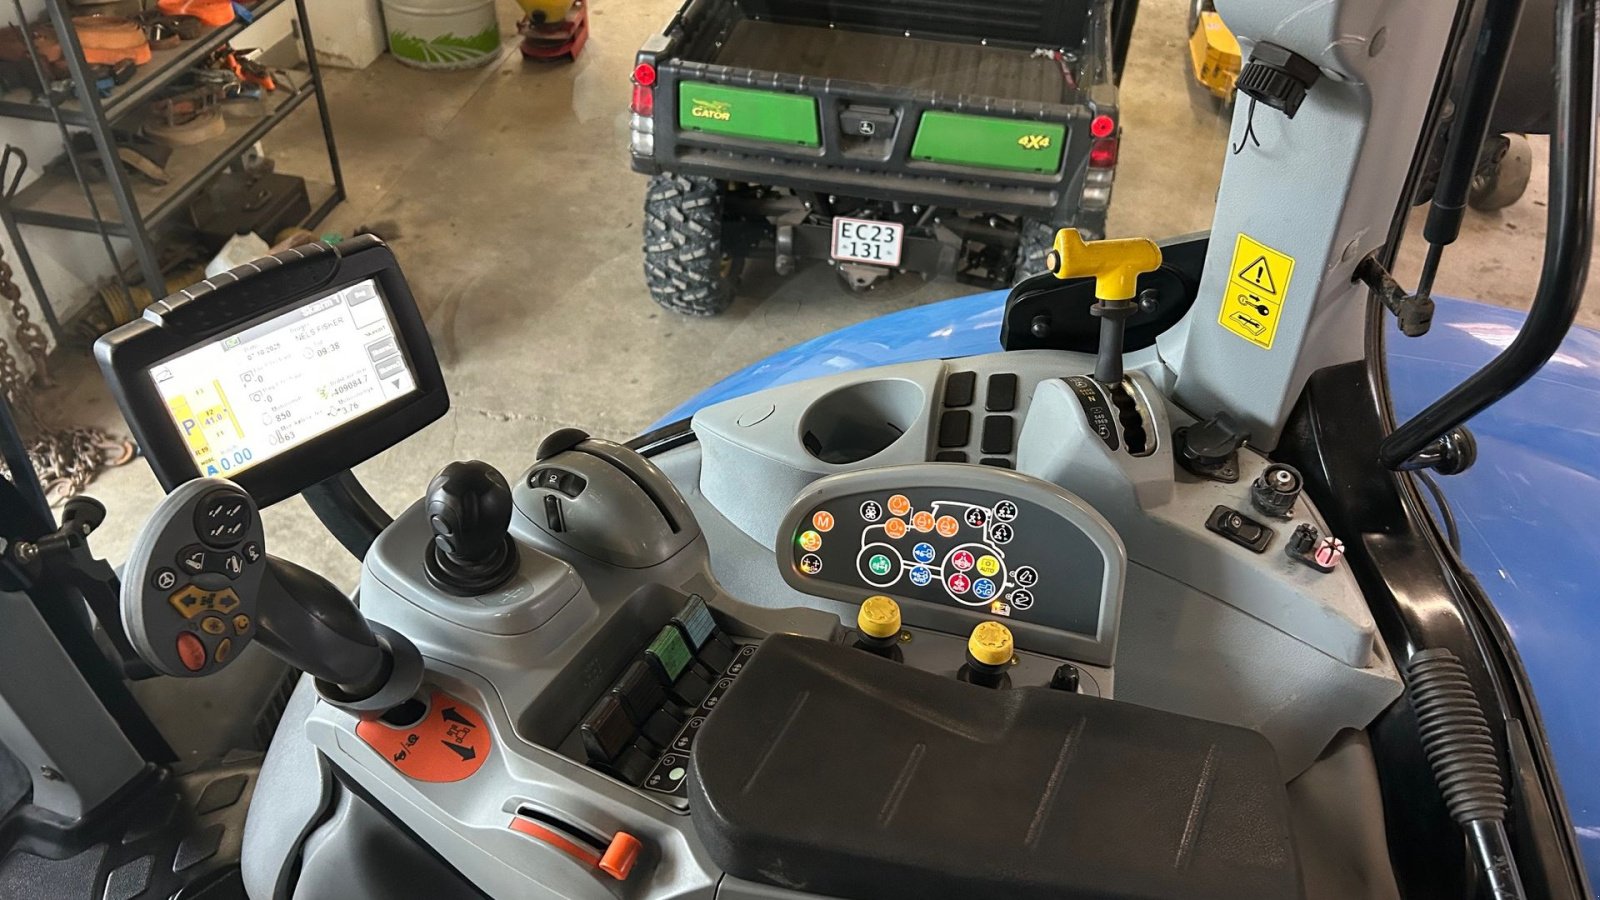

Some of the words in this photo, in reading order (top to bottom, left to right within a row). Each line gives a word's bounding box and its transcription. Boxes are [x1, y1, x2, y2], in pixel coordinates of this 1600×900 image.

[692, 106, 731, 121] GATOR
[842, 222, 895, 243] EC23
[850, 241, 882, 260] 131
[315, 341, 340, 357] 09:38
[341, 401, 359, 414] 3.76
[203, 413, 223, 426] 41.0
[274, 409, 292, 422] 850
[181, 417, 199, 436] P
[283, 430, 296, 441] 63
[207, 464, 220, 477] A
[218, 446, 253, 470] 0.00
[817, 516, 829, 527] M
